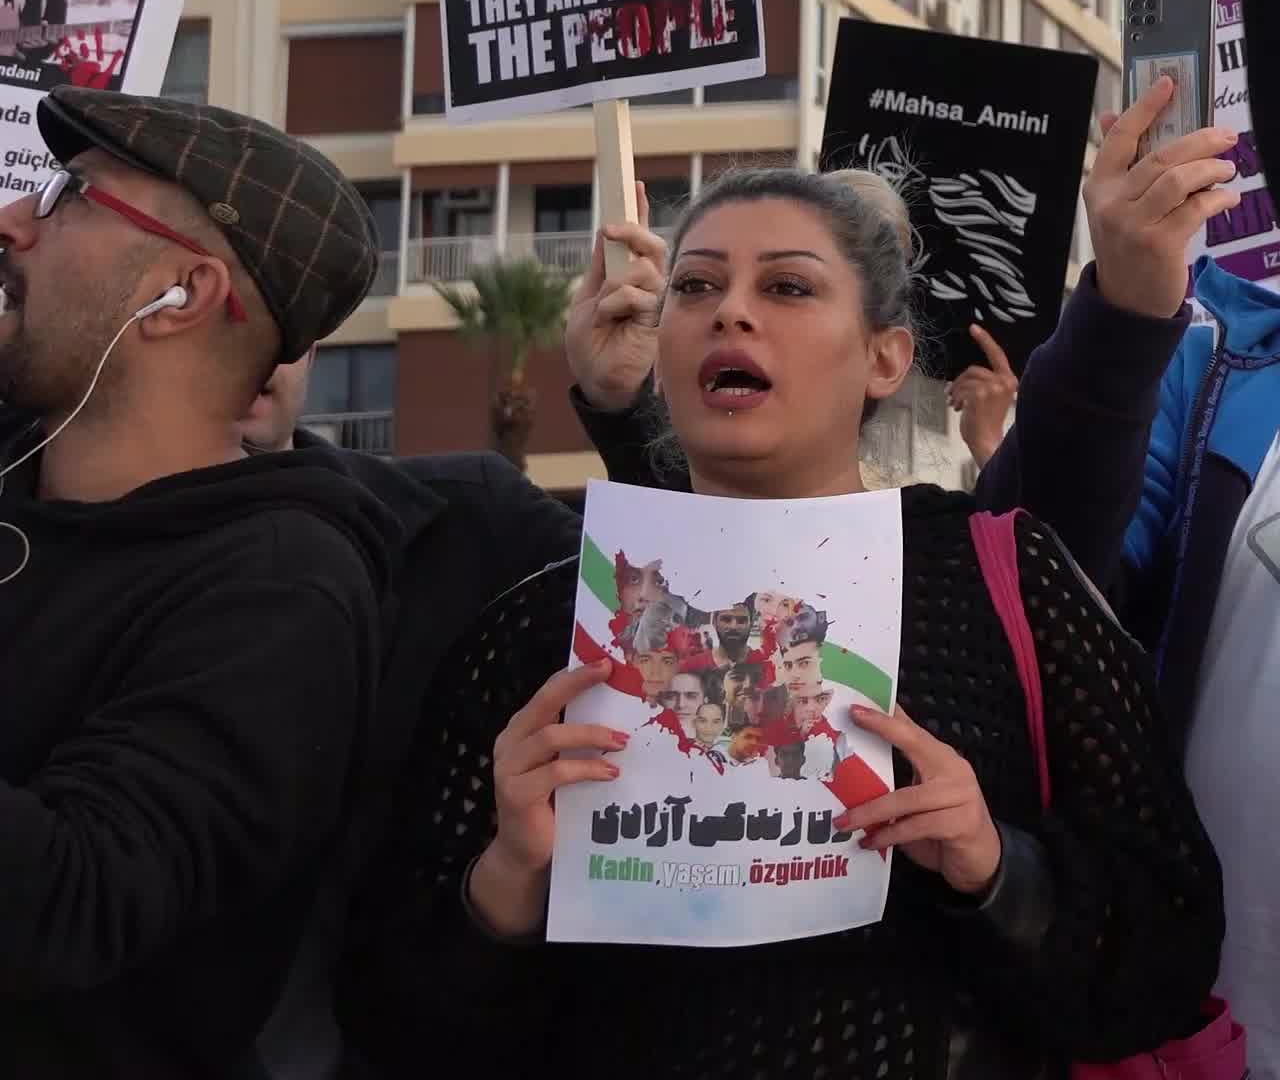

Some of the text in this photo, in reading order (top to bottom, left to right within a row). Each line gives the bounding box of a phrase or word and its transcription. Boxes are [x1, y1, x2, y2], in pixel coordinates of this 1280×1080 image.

[468, 27, 553, 85] THE
[869, 88, 1049, 135] #Mahsa_Amini
[749, 853, 849, 886] özgürlük
